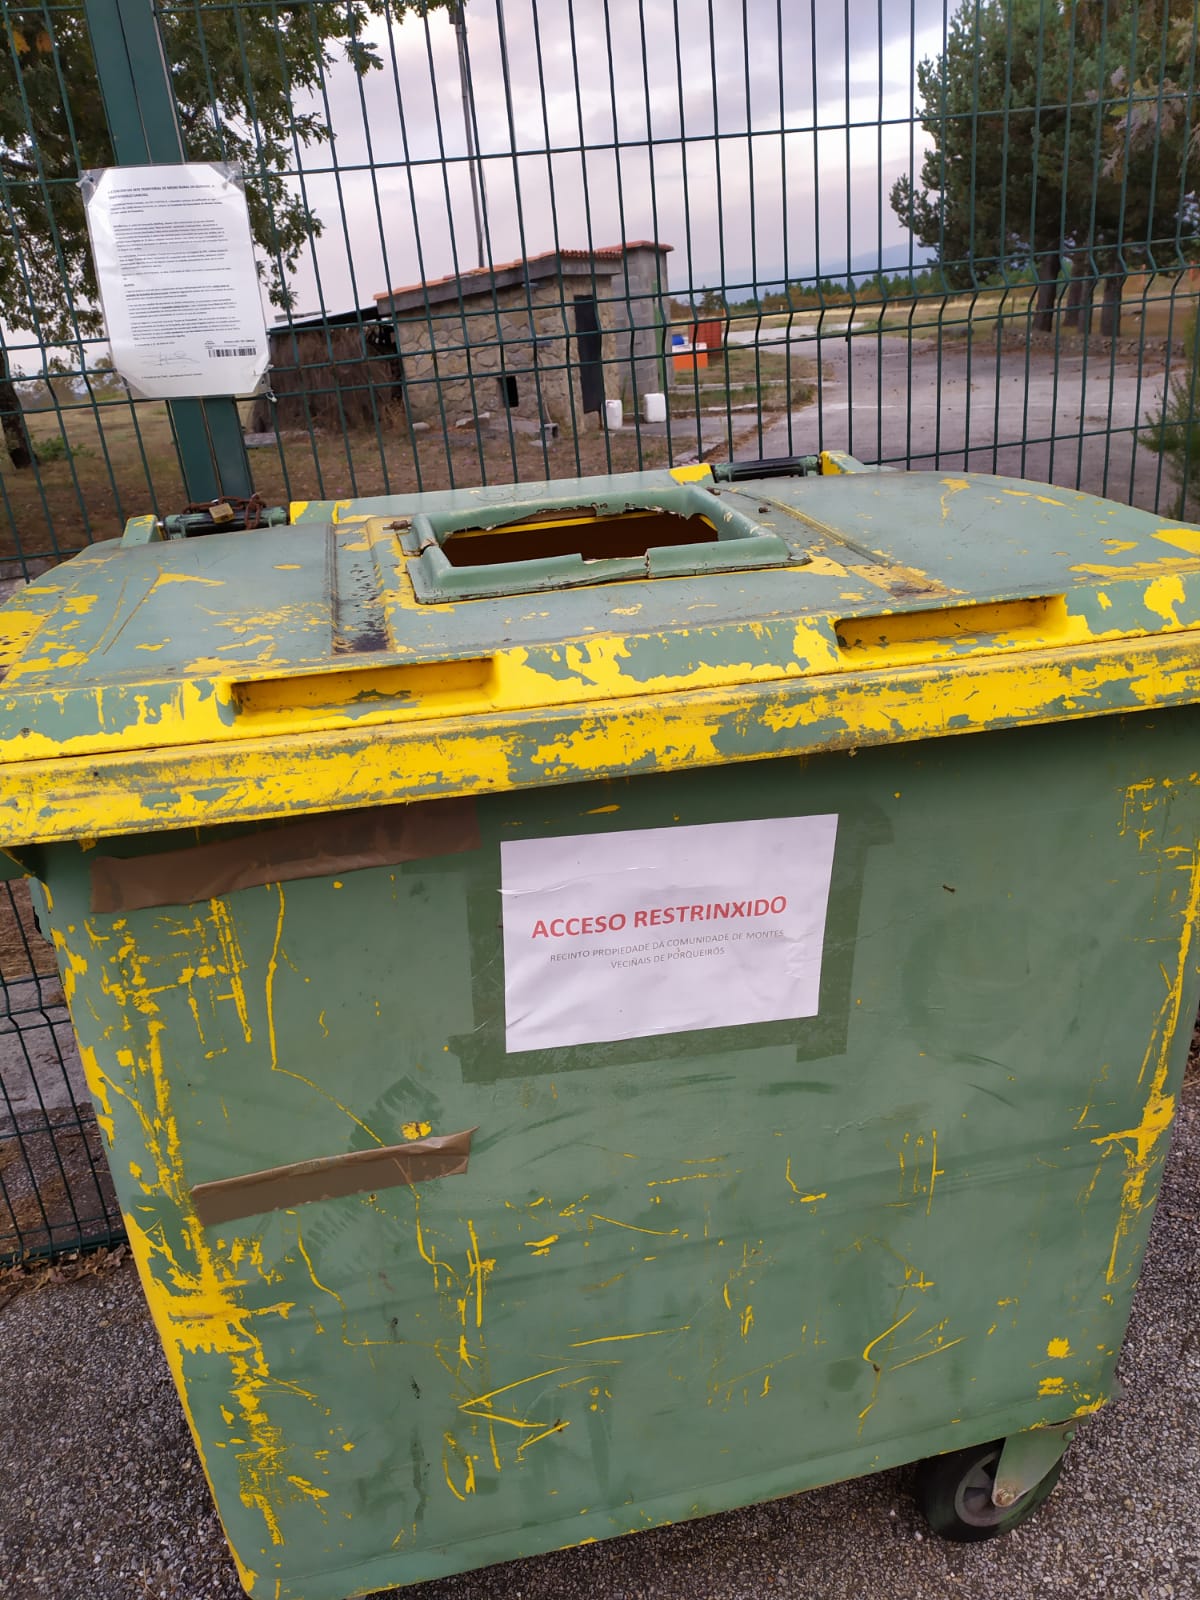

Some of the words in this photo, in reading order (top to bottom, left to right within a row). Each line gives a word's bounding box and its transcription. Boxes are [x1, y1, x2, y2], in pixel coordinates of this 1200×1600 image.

[532, 913, 626, 939] ACCESO
[633, 895, 788, 929] RESTRINXIDO
[550, 950, 590, 963] RECINTO
[592, 943, 650, 957] PROPIEDADE
[652, 941, 665, 950] DA
[666, 933, 729, 948] COMUNIDADE
[732, 931, 743, 941] DE
[746, 929, 784, 940] MONTES
[653, 954, 665, 963] DE
[667, 946, 726, 960] PORQUEIROS
